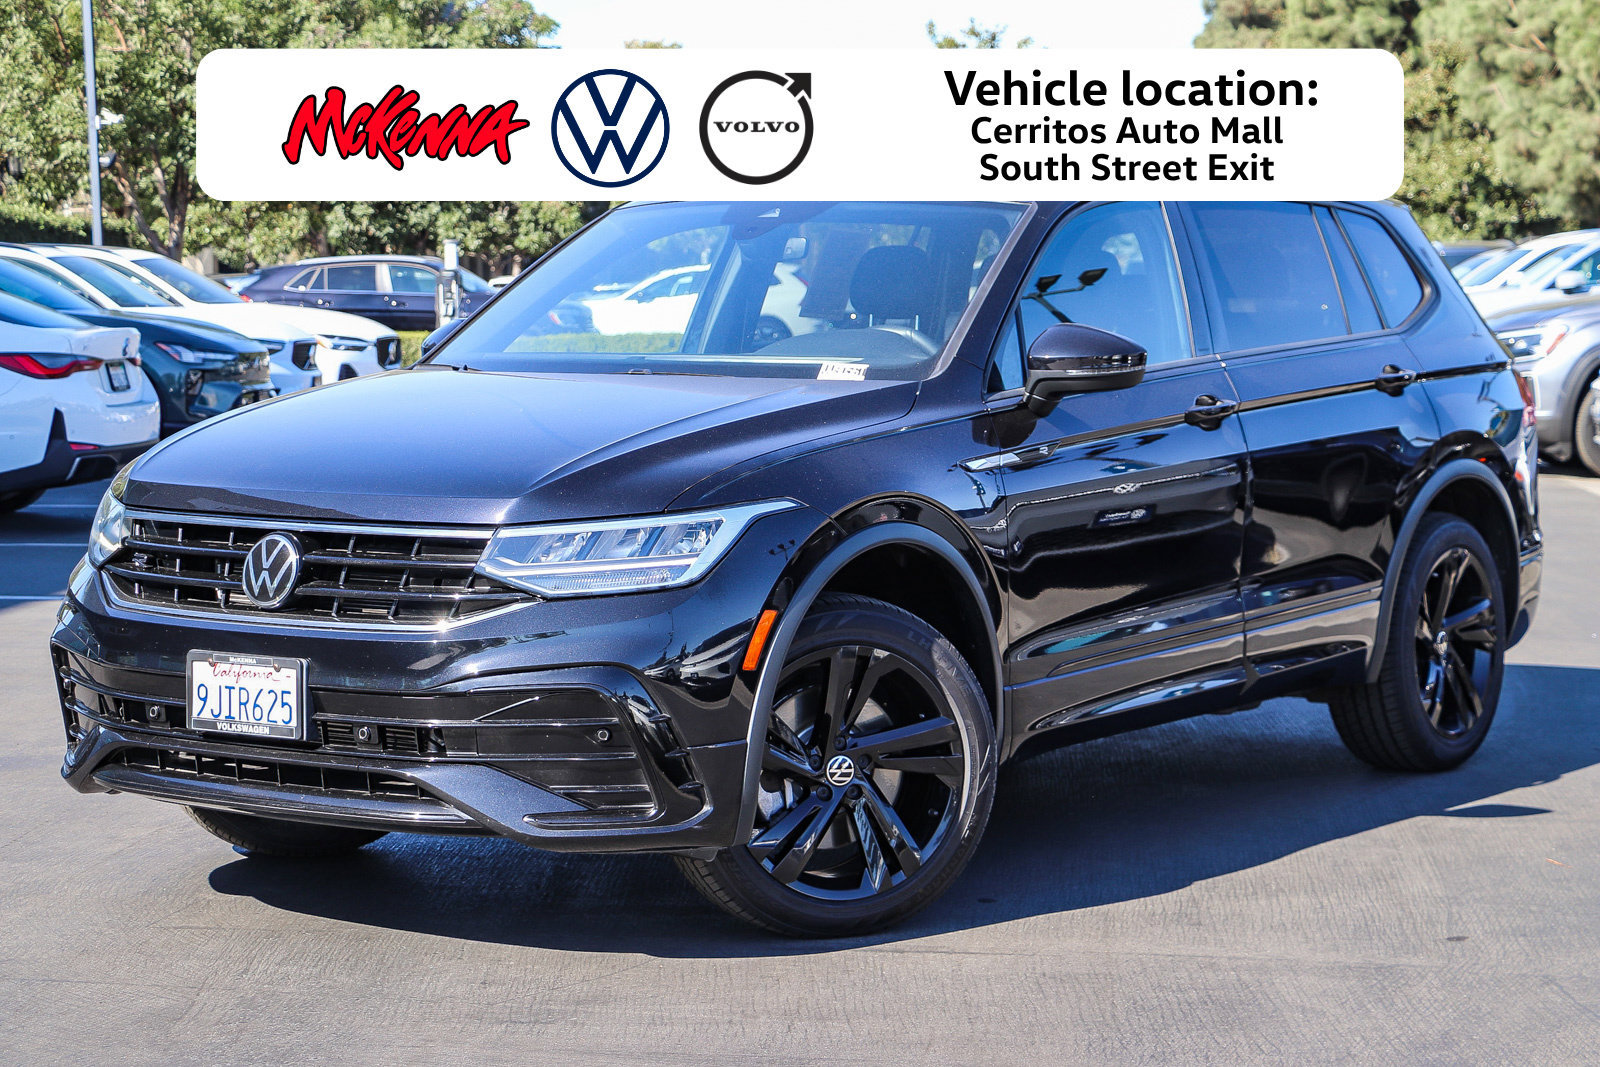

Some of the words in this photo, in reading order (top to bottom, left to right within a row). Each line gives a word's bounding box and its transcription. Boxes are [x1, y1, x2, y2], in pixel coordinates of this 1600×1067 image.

[213, 662, 274, 684] California
[197, 683, 293, 725] 9JIR625
[216, 721, 270, 735] VOLKSWAGEN
